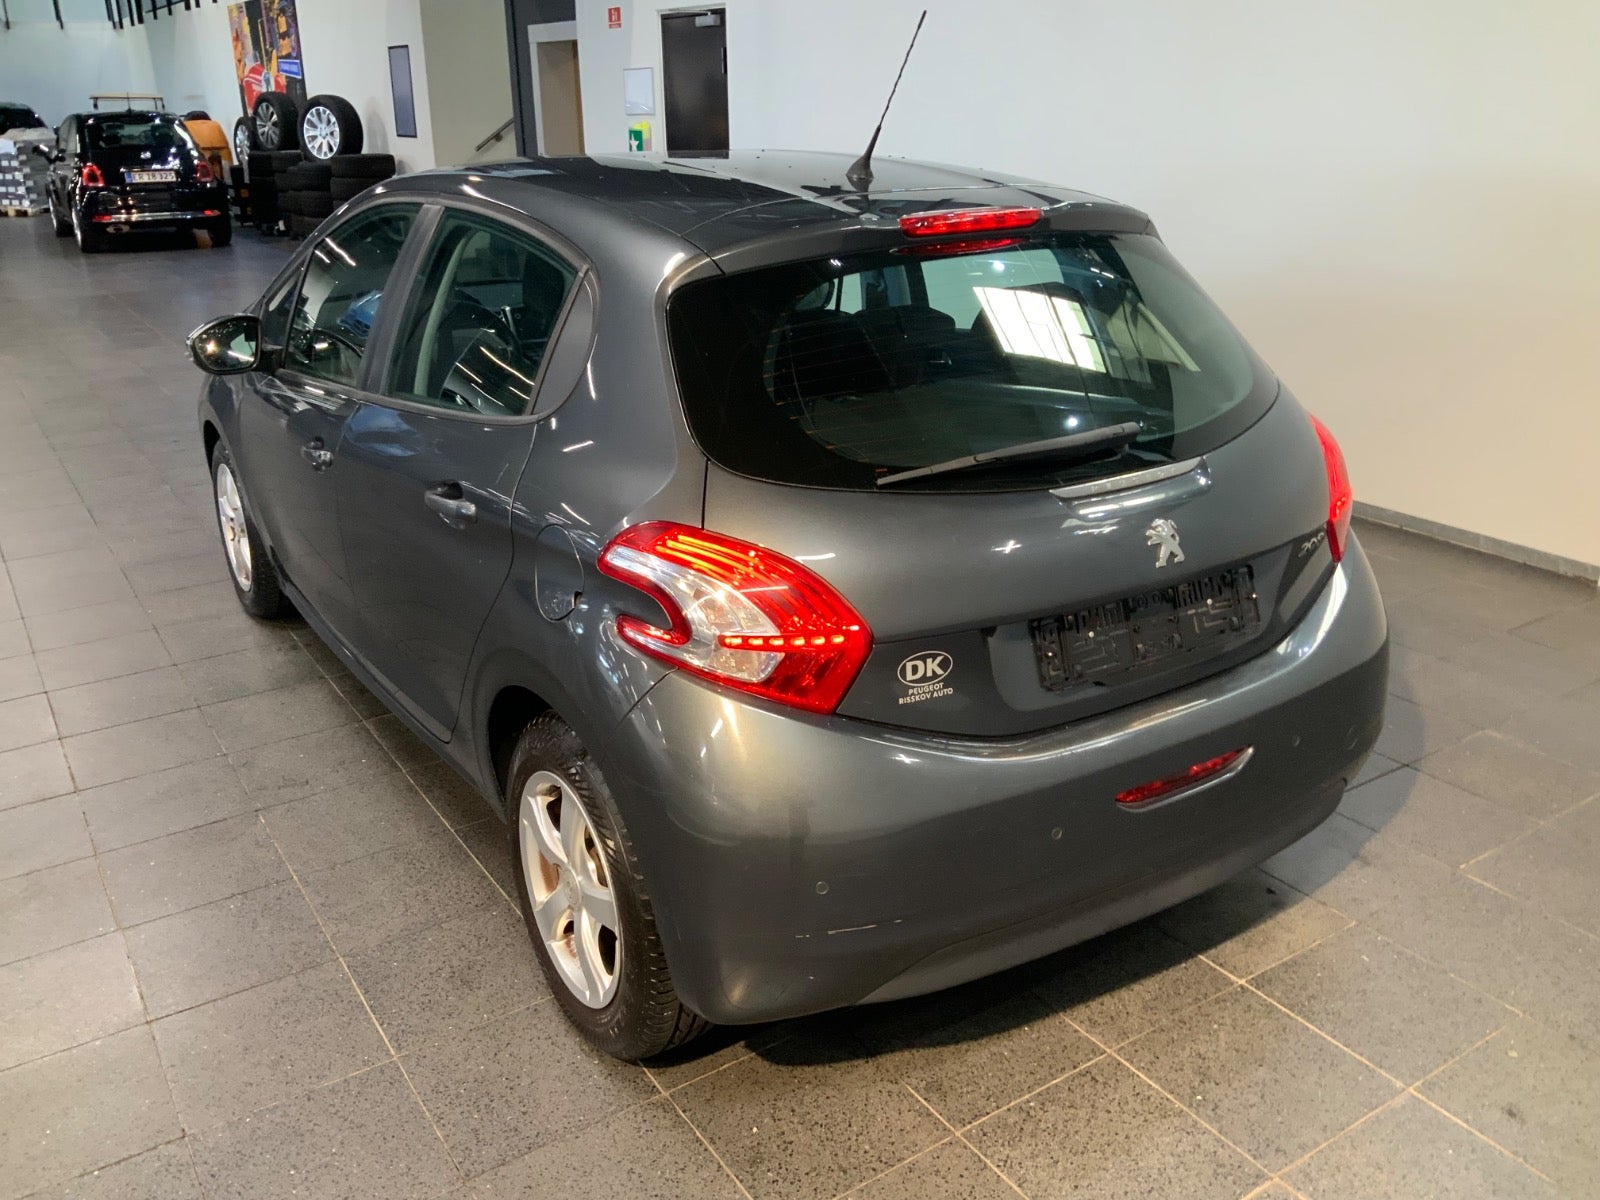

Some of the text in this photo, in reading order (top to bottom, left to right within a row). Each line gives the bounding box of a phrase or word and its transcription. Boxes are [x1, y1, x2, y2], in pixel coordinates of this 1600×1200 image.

[906, 655, 944, 681] DK
[899, 688, 953, 705] RISSKOV AUTO
[908, 683, 944, 695] PEUGEOT
